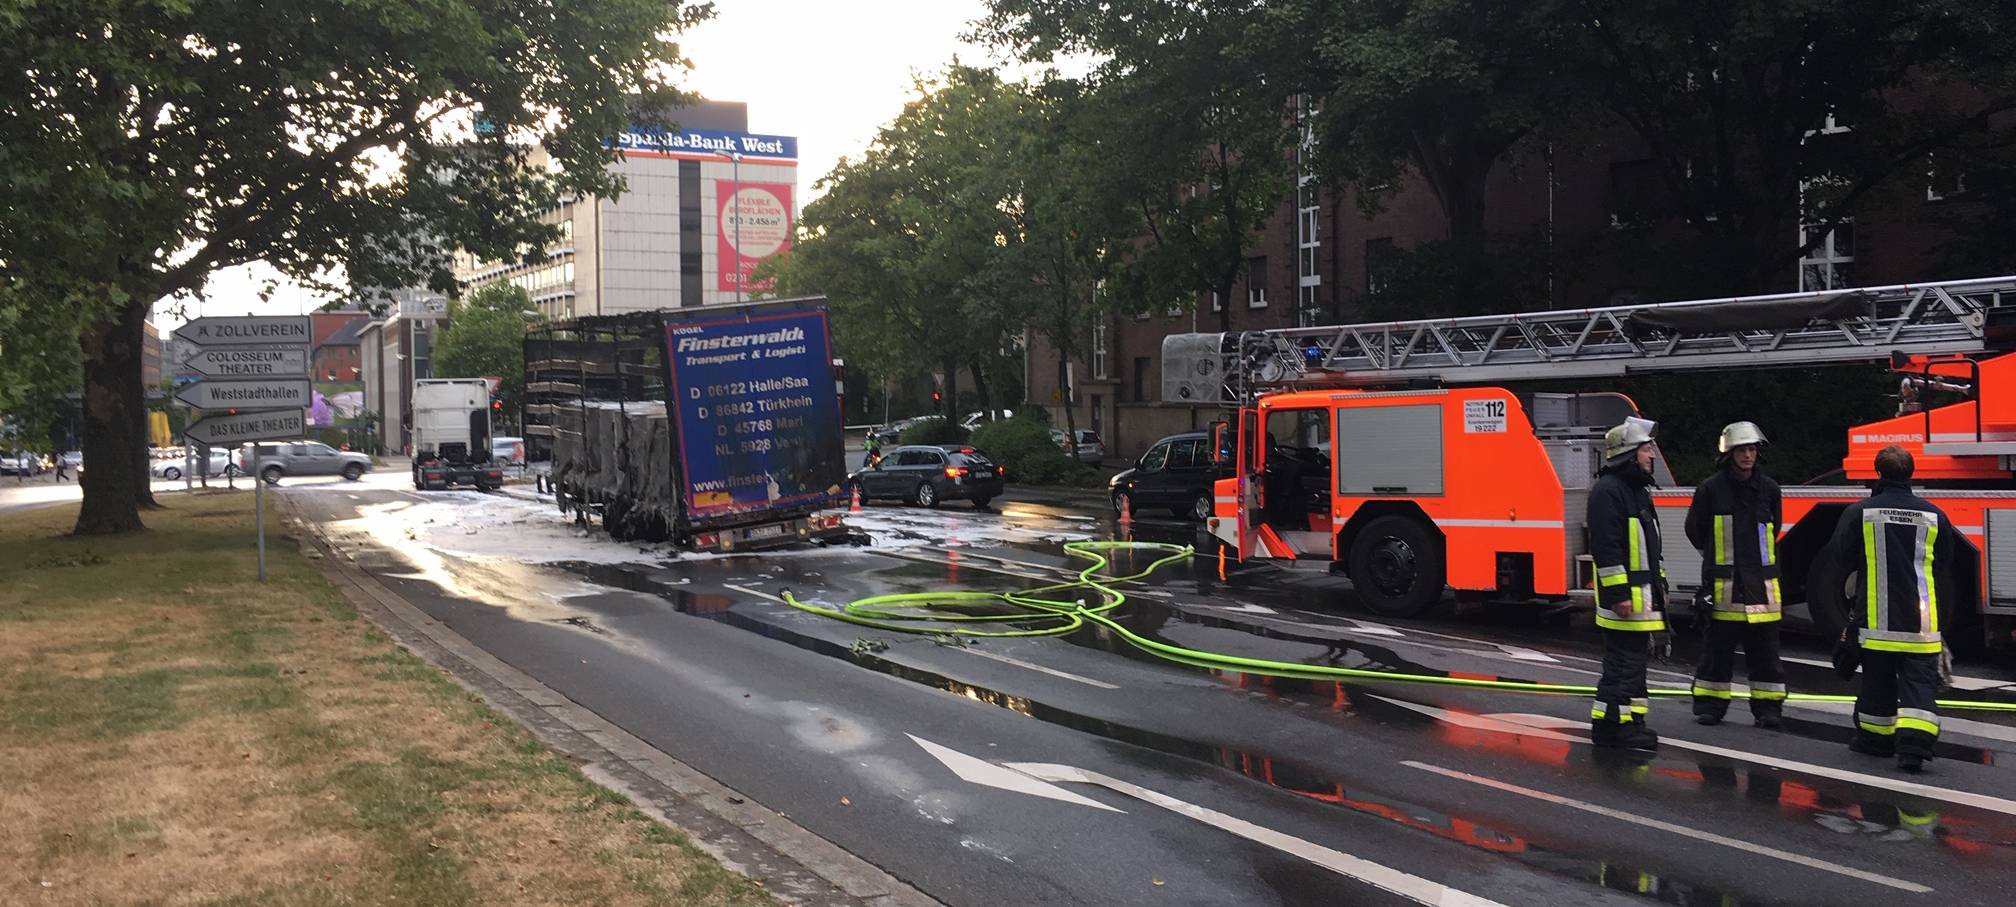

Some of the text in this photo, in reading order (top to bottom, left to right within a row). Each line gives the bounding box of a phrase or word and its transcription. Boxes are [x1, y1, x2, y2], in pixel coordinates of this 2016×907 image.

[741, 137, 783, 154] West
[215, 324, 304, 337] ZOLLVEREIN
[207, 352, 283, 362] COLOSSEUM
[686, 352, 747, 366] Transport
[751, 350, 761, 359] &
[219, 363, 273, 374] THEATER
[210, 386, 300, 401] Weststadthallen
[690, 387, 701, 400] D
[708, 382, 746, 397] 06122
[698, 406, 709, 419] D
[1485, 400, 1505, 418] 112
[210, 418, 300, 437] DAS KLEINE THEATER
[717, 424, 727, 437] D
[1867, 434, 1923, 443] MAGIRUS
[715, 444, 734, 457] NL
[1880, 509, 1923, 518] FEUERWEHR
